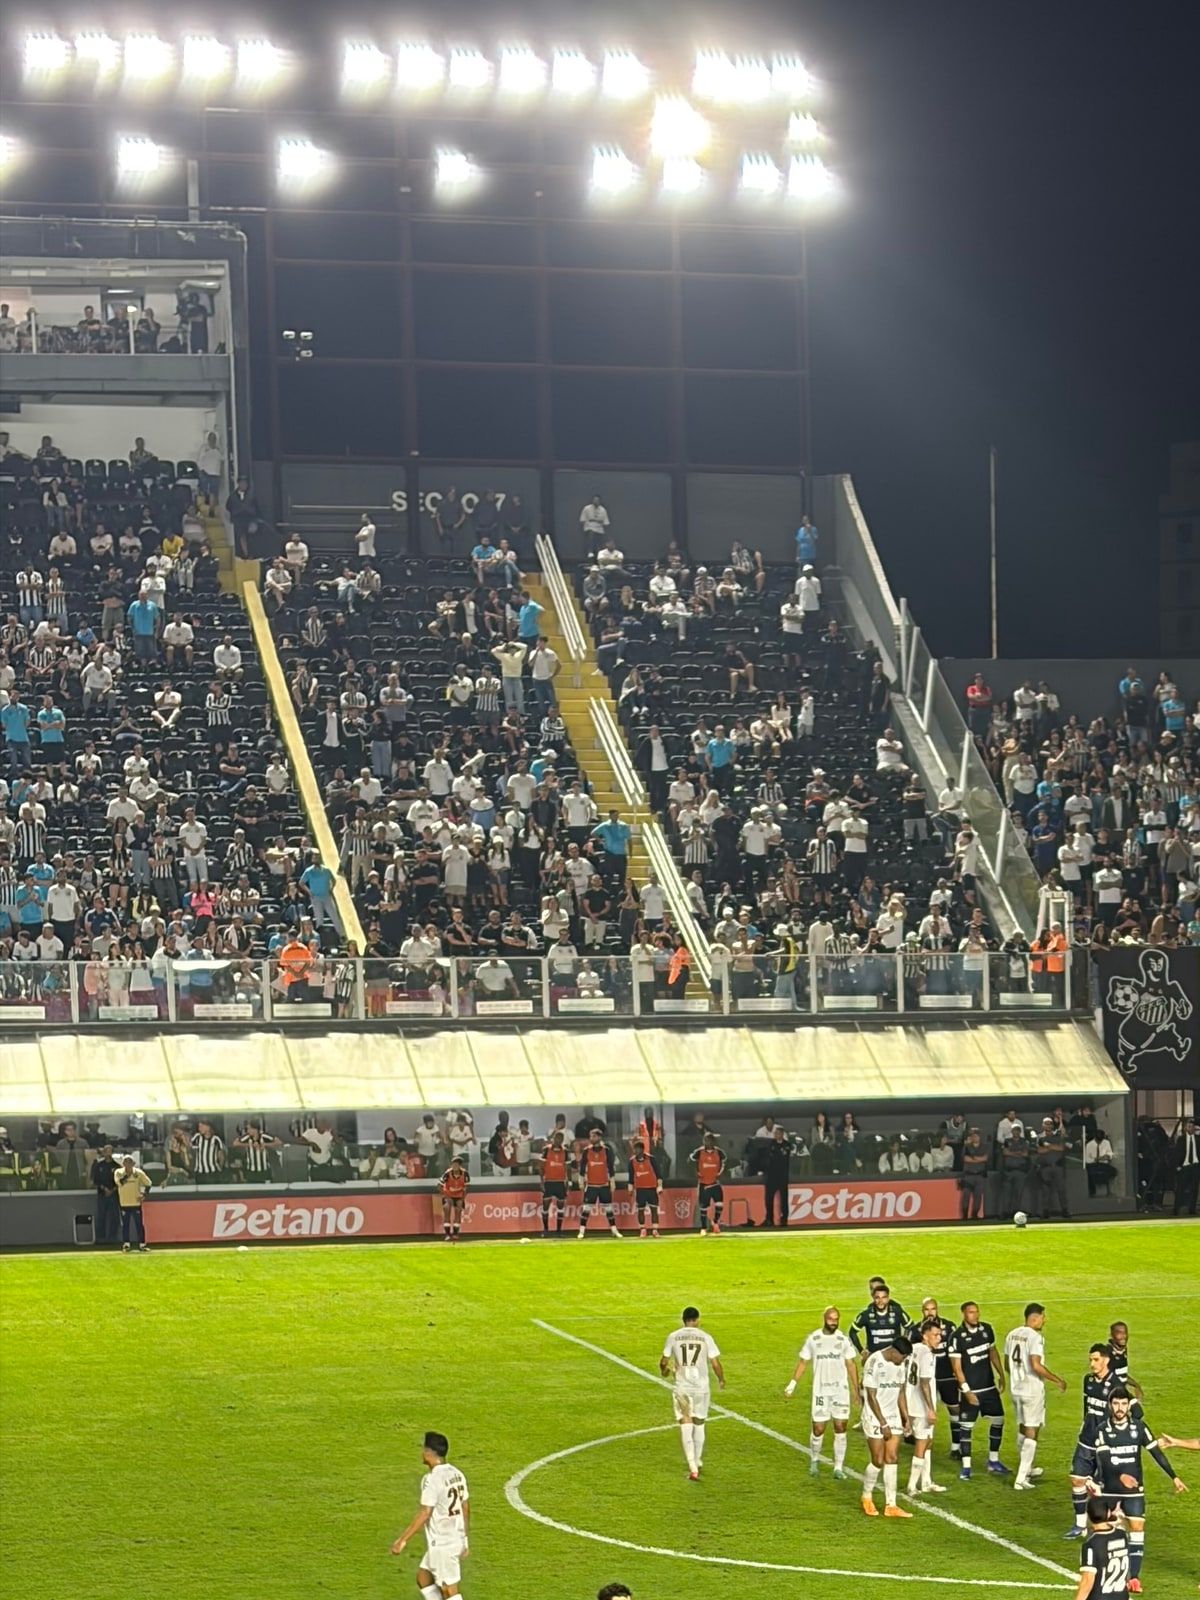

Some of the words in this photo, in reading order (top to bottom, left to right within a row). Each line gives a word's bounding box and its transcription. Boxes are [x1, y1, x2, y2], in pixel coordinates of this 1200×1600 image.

[483, 1204, 518, 1219] Copa
[788, 1188, 921, 1220] Betano
[213, 1203, 364, 1238] Betano
[680, 1343, 701, 1366] 17
[1011, 1343, 1022, 1366] 4
[815, 1396, 824, 1406] 16
